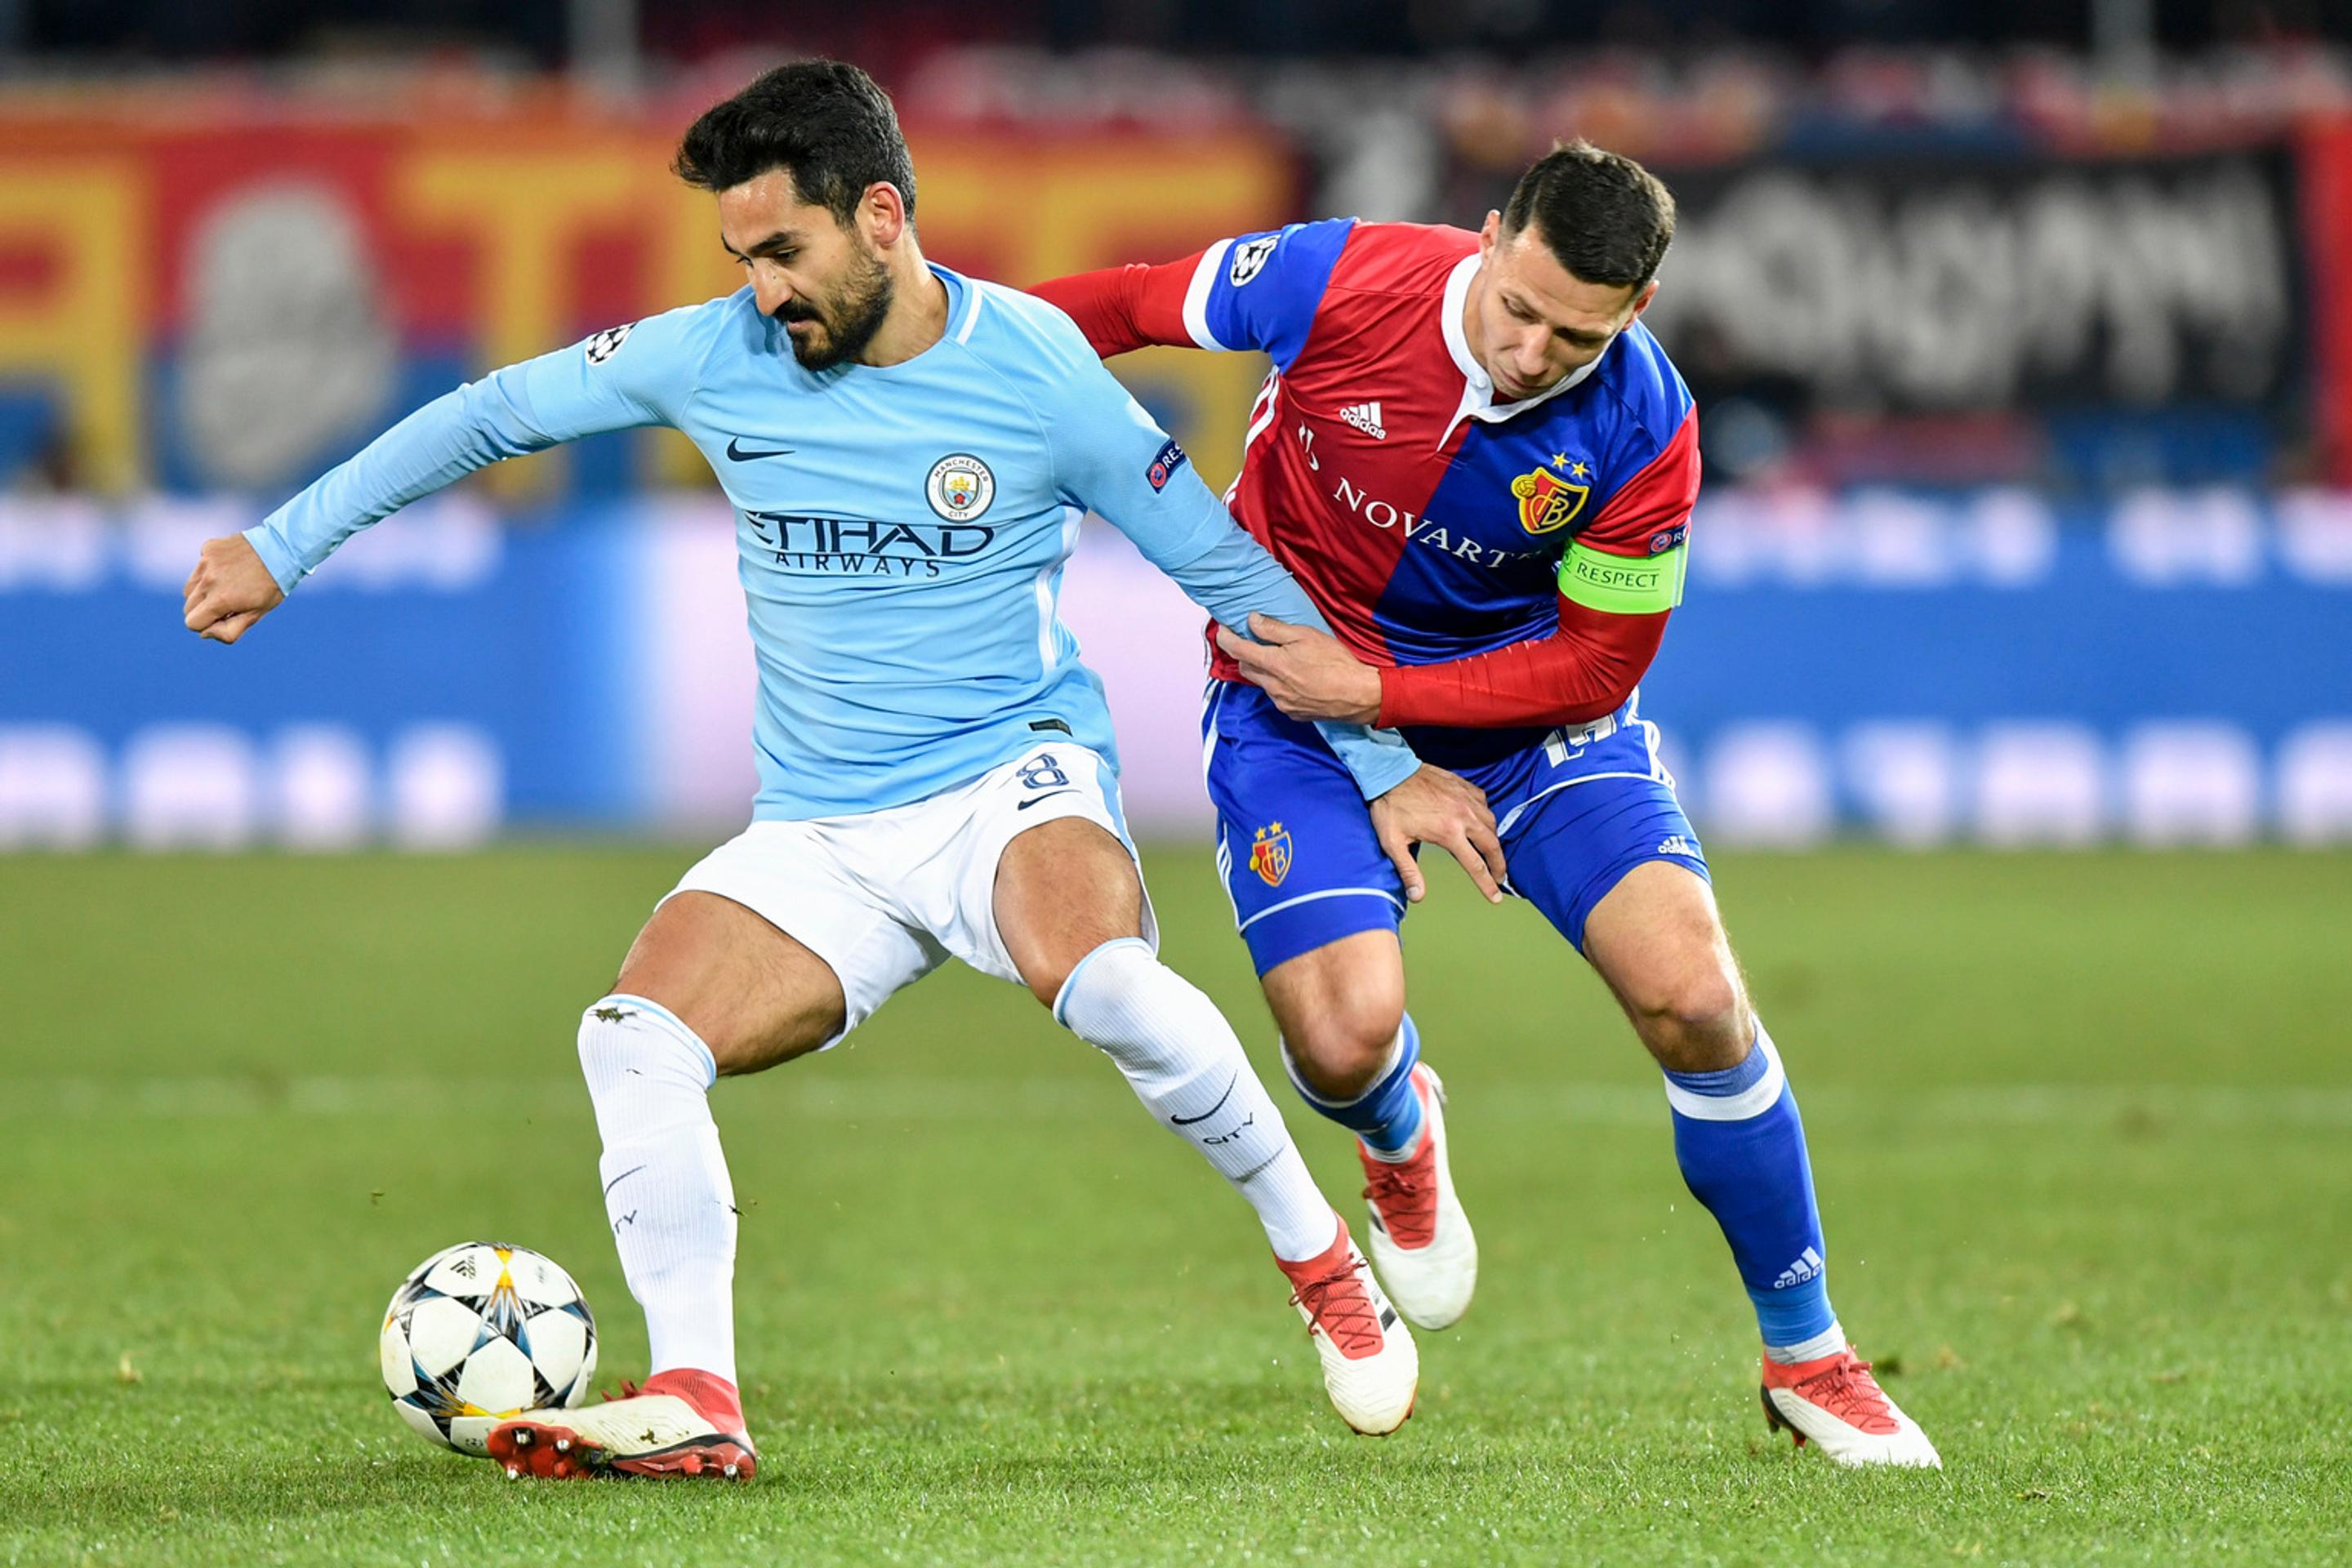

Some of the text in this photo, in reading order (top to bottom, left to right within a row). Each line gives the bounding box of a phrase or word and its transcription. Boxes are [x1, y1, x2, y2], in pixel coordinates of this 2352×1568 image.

[1339, 408, 1387, 439] adidas
[933, 458, 990, 482] MANCHESTER
[948, 510, 969, 519] CITY
[1333, 477, 1542, 568] NOVART
[744, 510, 996, 557] ETIHAD
[775, 551, 941, 578] AIRWAYS
[1577, 562, 1660, 588] RESPECT
[1015, 753, 1070, 789] 8
[1203, 1111, 1253, 1145] CITY
